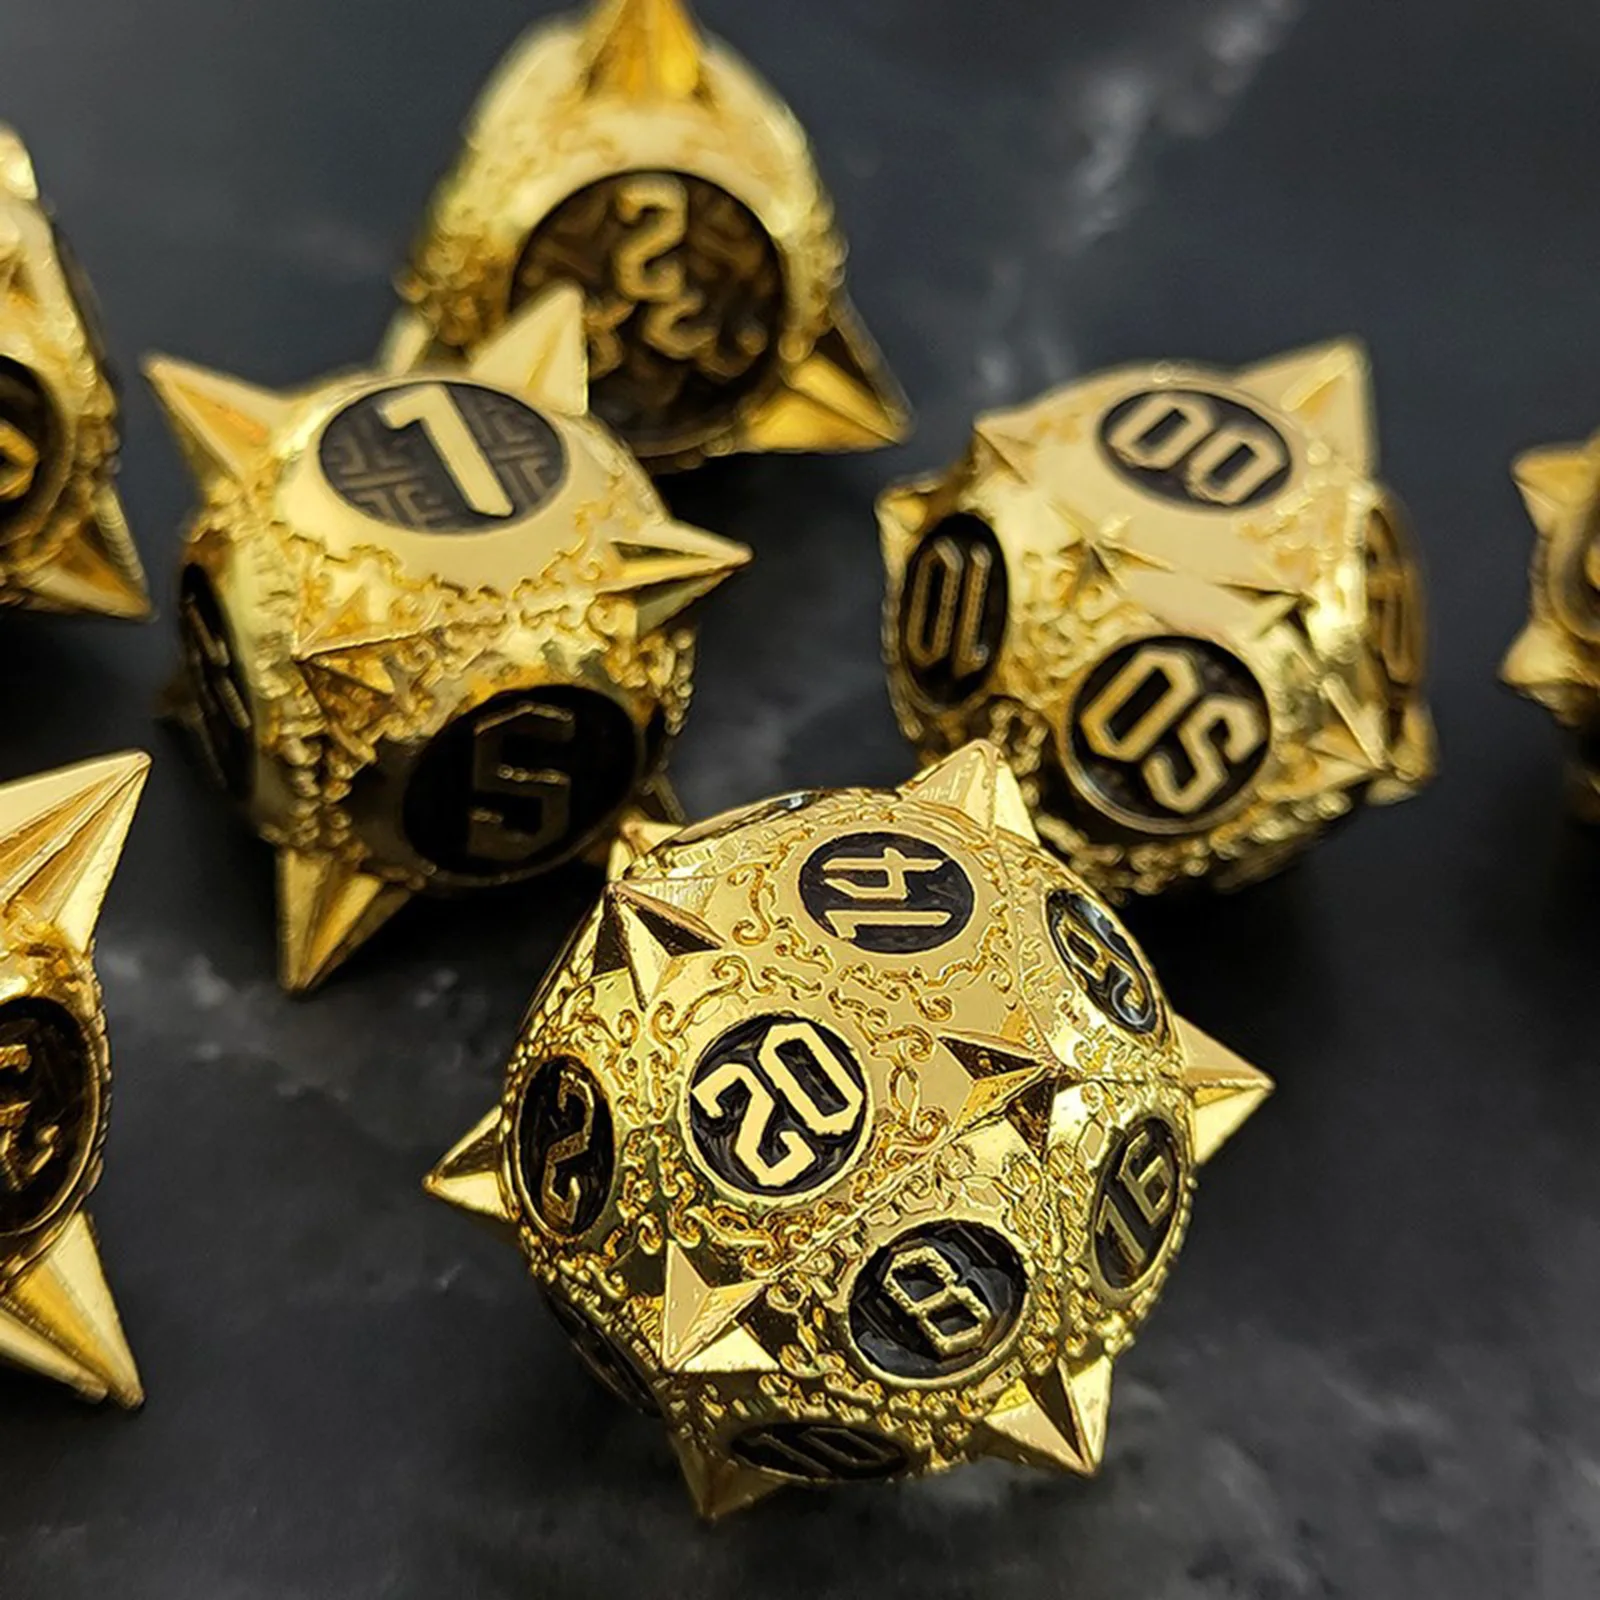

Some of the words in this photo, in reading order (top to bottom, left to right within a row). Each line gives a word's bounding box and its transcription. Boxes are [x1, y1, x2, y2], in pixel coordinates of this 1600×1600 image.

[379, 383, 514, 517] 1
[1107, 396, 1290, 505] 00
[906, 532, 991, 672] 10
[465, 699, 577, 861] 5
[823, 848, 961, 940] 14
[543, 1067, 597, 1226] 2
[690, 1018, 864, 1188] 20
[1094, 1132, 1176, 1275] 16
[880, 1243, 994, 1358] 8
[746, 1424, 903, 1478] 10
